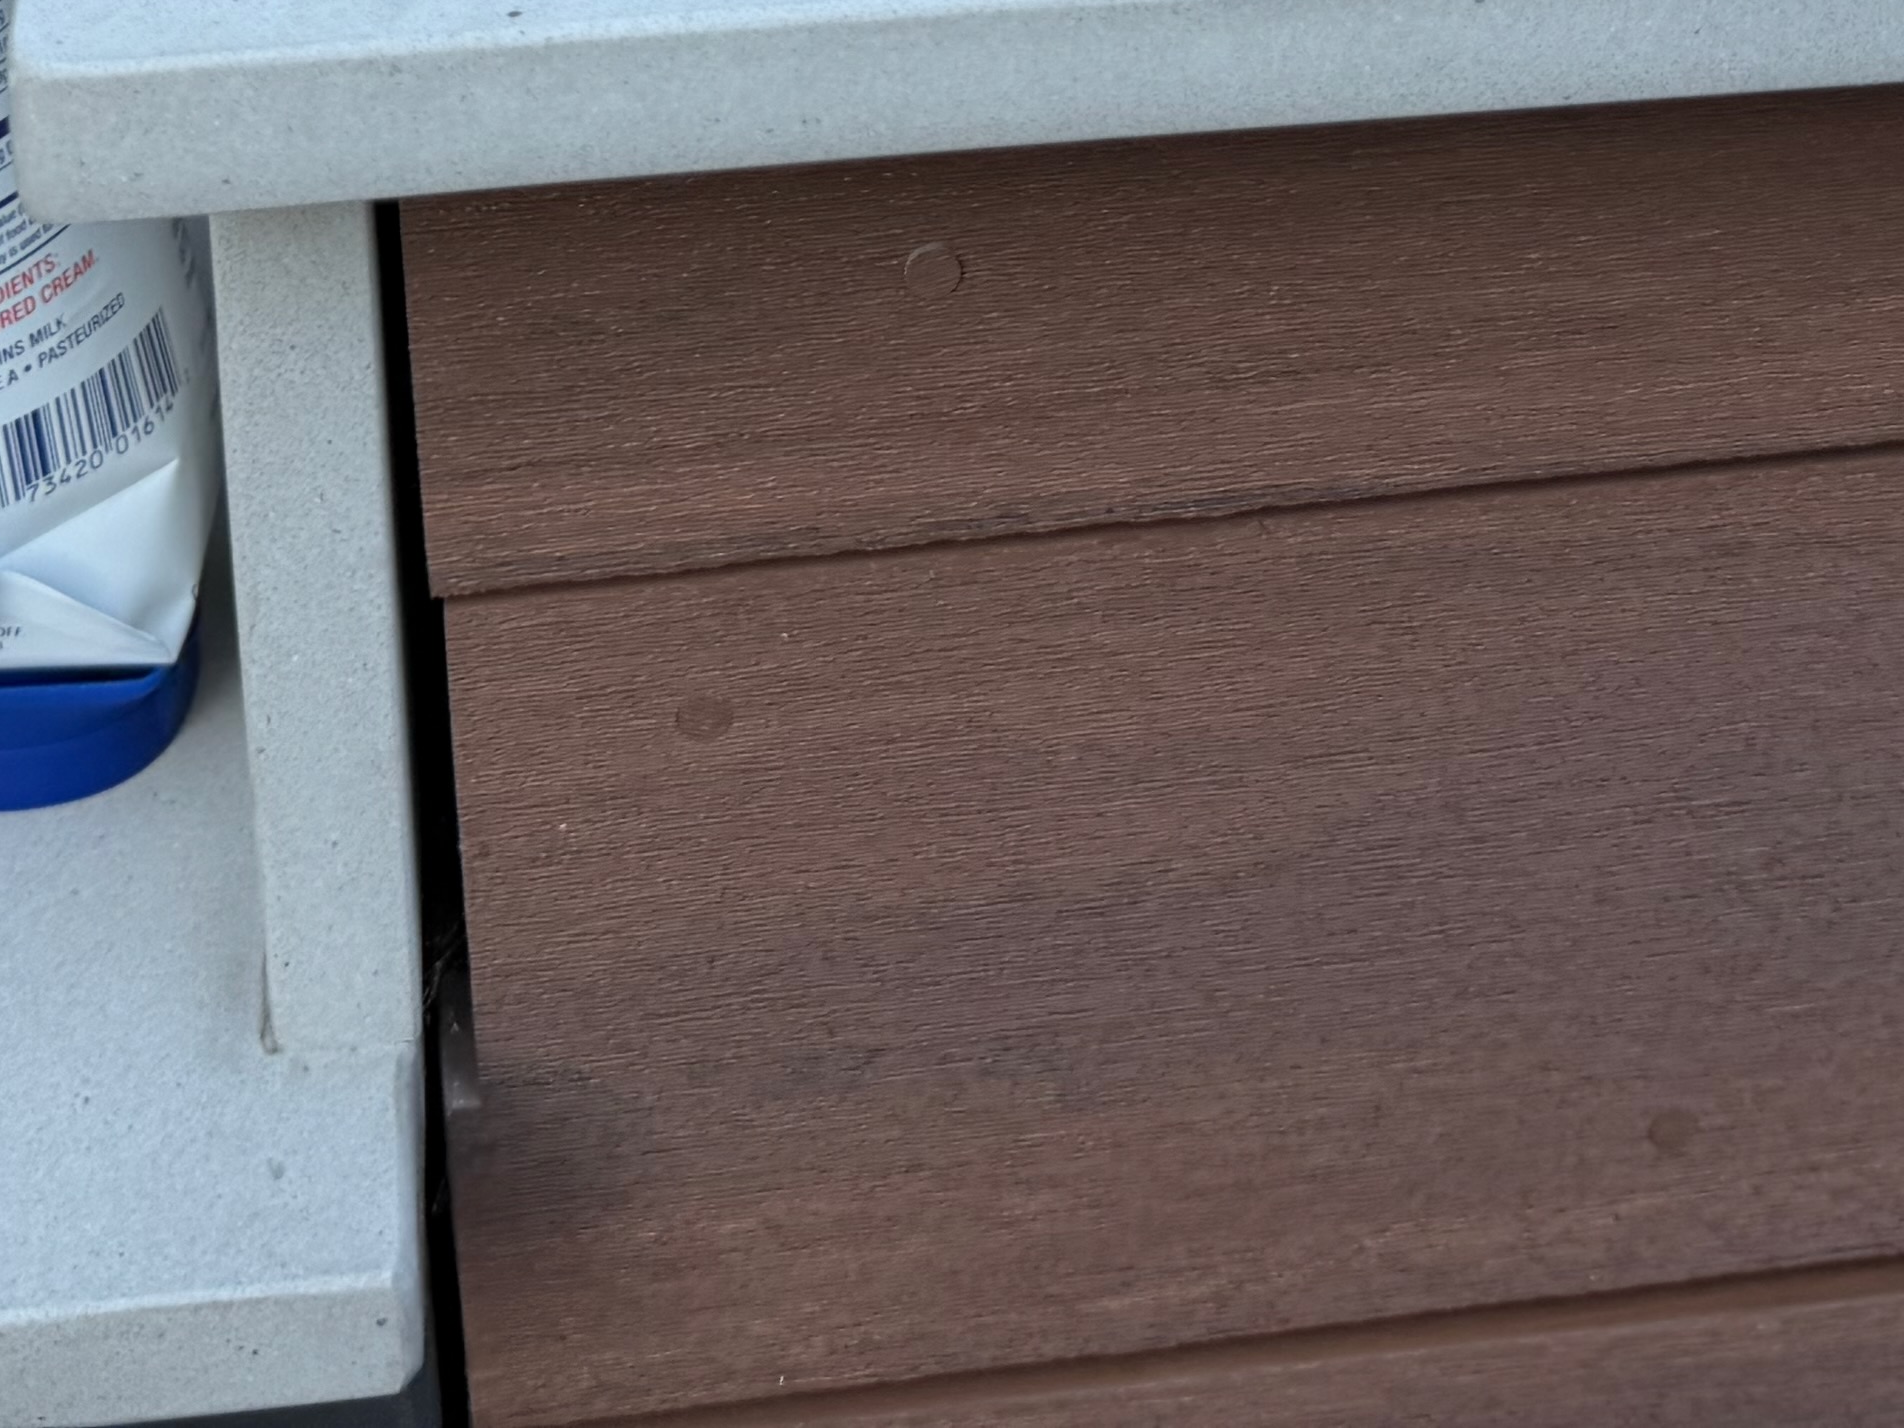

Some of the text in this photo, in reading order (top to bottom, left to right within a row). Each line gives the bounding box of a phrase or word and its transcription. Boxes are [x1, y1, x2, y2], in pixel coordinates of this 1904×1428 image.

[7, 369, 20, 386] A
[38, 292, 126, 368] PASTEURIZED
[29, 312, 67, 349] MILK
[24, 448, 104, 502] 73420
